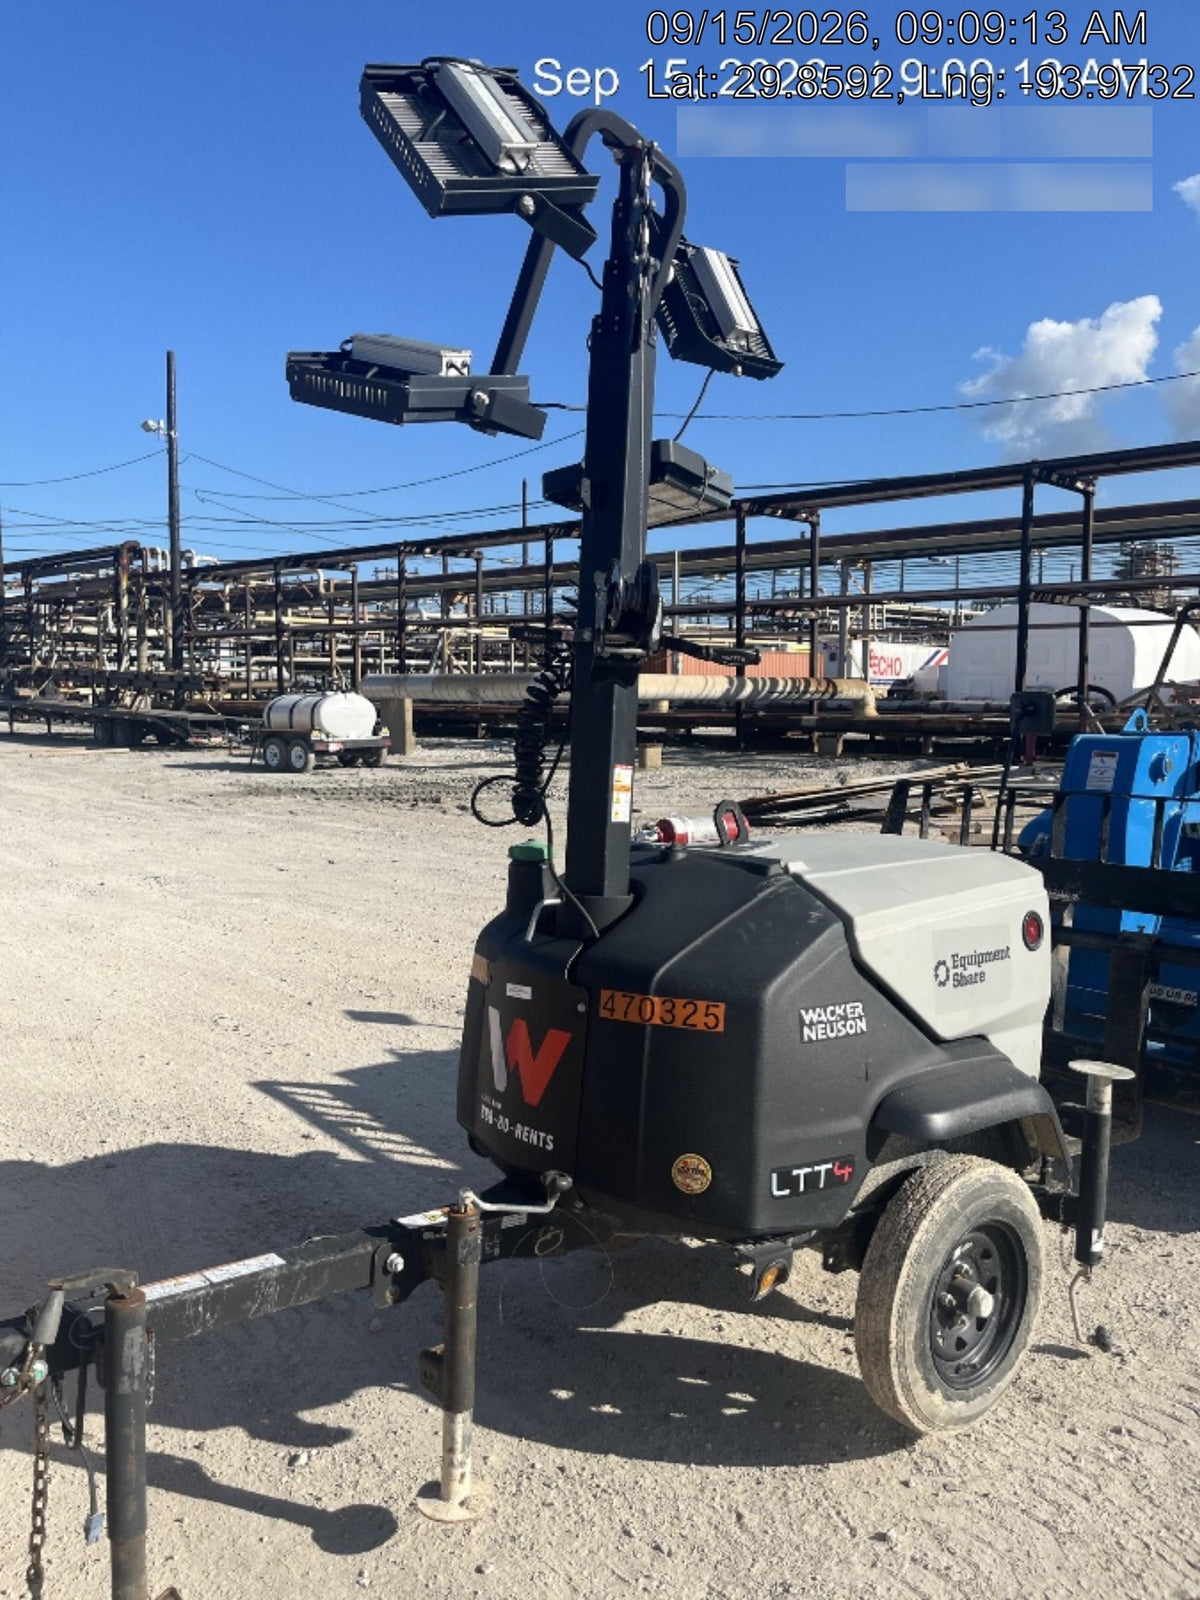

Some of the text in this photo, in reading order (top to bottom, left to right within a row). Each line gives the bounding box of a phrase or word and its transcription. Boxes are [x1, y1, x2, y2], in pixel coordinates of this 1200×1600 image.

[950, 945, 1011, 970] Equipment
[952, 968, 986, 989] Share
[601, 991, 720, 1031] 470325
[800, 1002, 865, 1025] WACKER
[802, 1017, 867, 1042] NEUSON
[771, 1160, 852, 1197] LTT4
